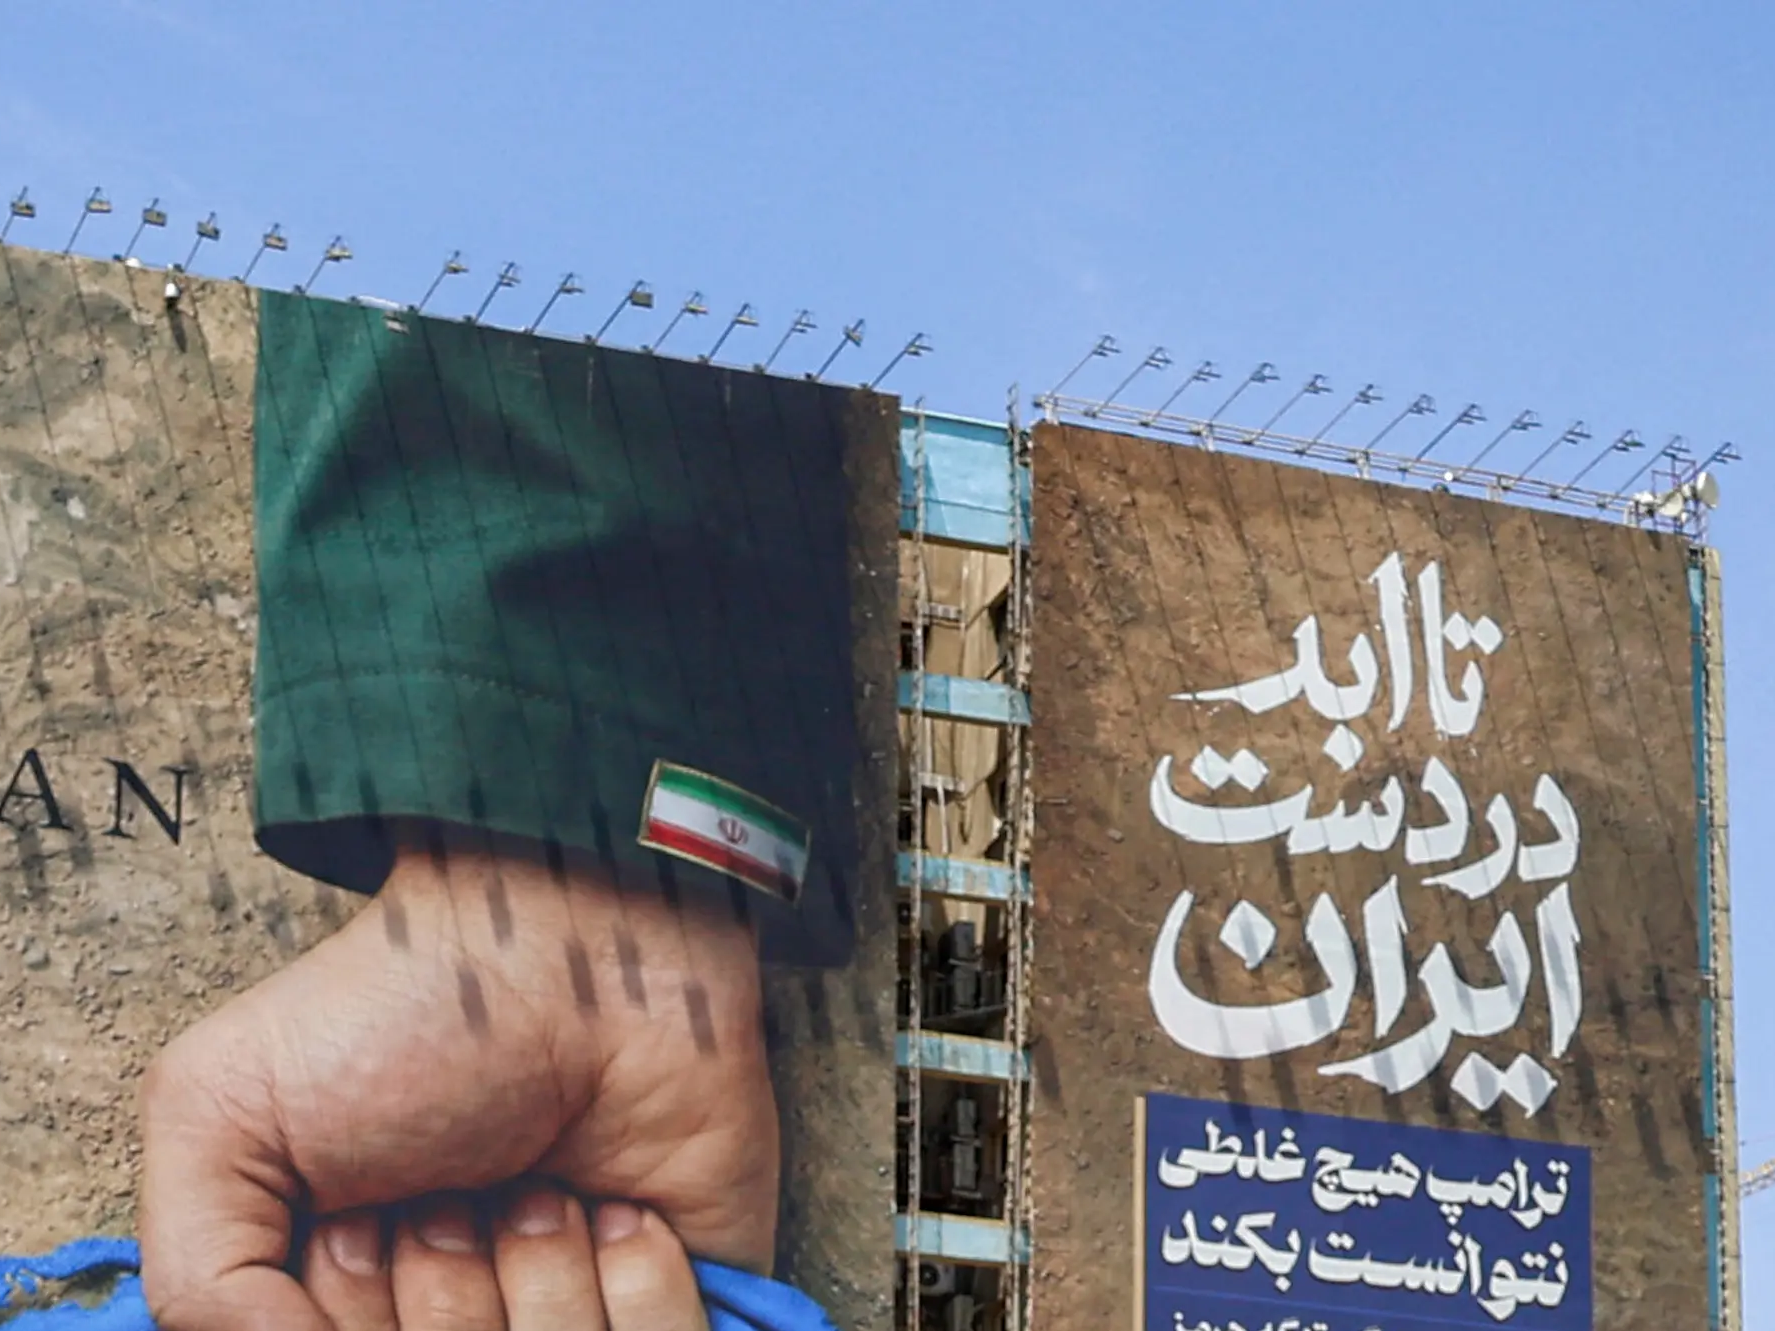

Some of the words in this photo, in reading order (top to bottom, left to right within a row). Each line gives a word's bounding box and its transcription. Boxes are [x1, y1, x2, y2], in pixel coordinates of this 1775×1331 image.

[1169, 551, 1413, 771] ابد
[1418, 560, 1504, 738] تا
[1150, 744, 1471, 864] دست
[1422, 773, 1580, 899] در
[1148, 874, 1583, 1119] ایران
[1158, 1120, 1307, 1188] غلطی
[1311, 1145, 1422, 1212] هیچ
[1425, 1157, 1571, 1229] ترامپ
[1161, 1210, 1302, 1293] بکند
[1308, 1228, 1571, 1322] نتوانست
